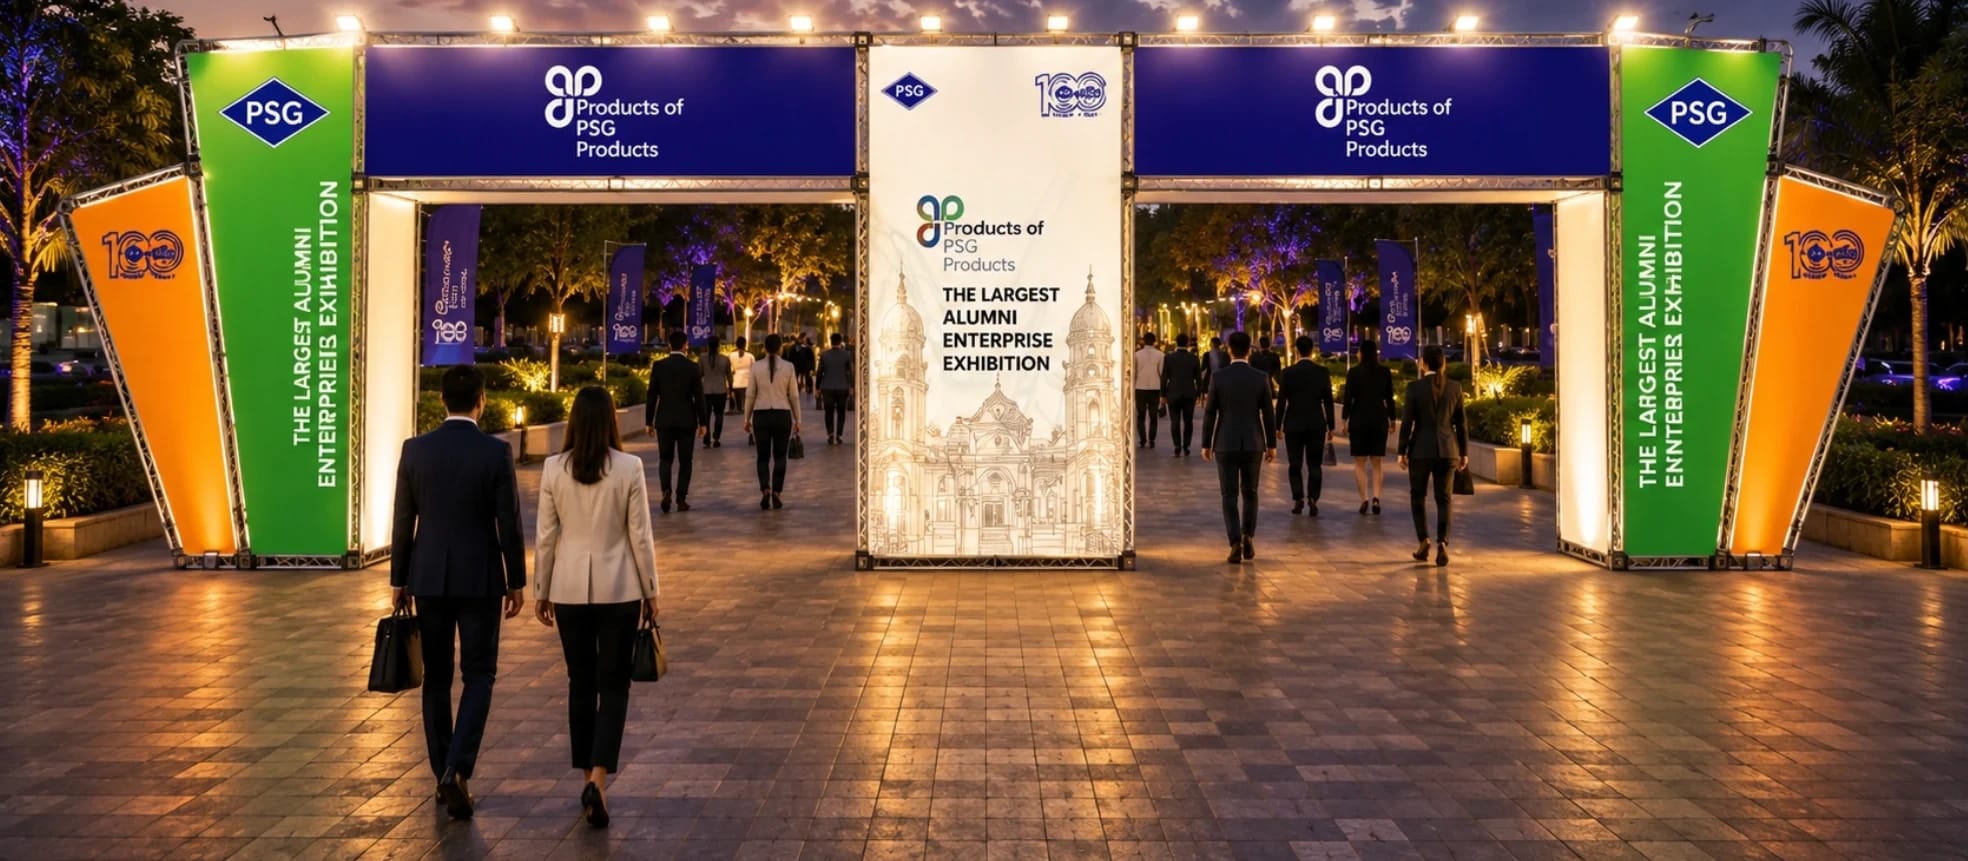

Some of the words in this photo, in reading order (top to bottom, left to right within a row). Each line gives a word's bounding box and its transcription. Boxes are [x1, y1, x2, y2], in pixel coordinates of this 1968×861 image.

[895, 84, 925, 98] PSG
[245, 100, 303, 126] PSG
[576, 98, 660, 116] Products
[664, 98, 685, 116] of
[1346, 98, 1429, 116] Products
[1432, 98, 1453, 116] of
[1670, 100, 1728, 126] PSG
[576, 119, 616, 137] PSG
[1346, 119, 1386, 137] PSG
[576, 140, 659, 158] Products
[1346, 139, 1428, 158] Products
[942, 220, 1022, 236] Products
[1026, 220, 1045, 236] of
[942, 238, 979, 254] PSG
[942, 257, 1016, 273] Products
[942, 286, 977, 303] THE
[981, 286, 1061, 303] LARGEST
[942, 309, 1018, 326] ALUMNI
[942, 332, 1054, 349] ENTERPRISE
[293, 316, 312, 401] LARGEST
[942, 355, 1051, 372] EXHIBITION
[1638, 332, 1657, 437] LARGEST
[293, 405, 313, 446] THE
[1638, 445, 1657, 489] THE
